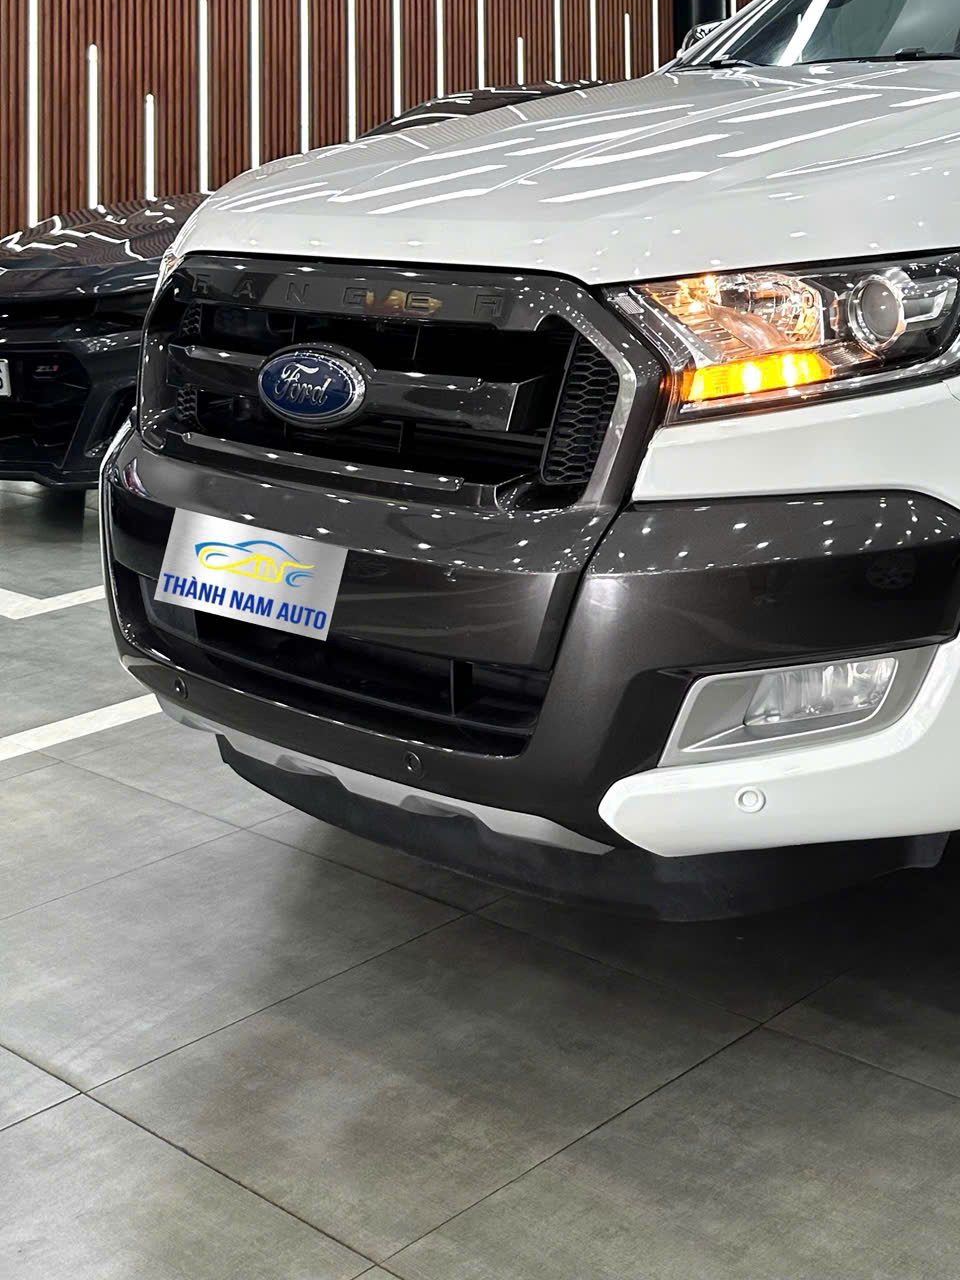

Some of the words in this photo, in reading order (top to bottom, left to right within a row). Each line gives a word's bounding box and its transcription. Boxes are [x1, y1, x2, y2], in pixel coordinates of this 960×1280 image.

[191, 272, 505, 318] RANGER
[273, 361, 332, 406] Ford
[163, 572, 227, 606] THÀNH
[229, 588, 274, 618] NAM
[276, 601, 328, 631] AUTO
